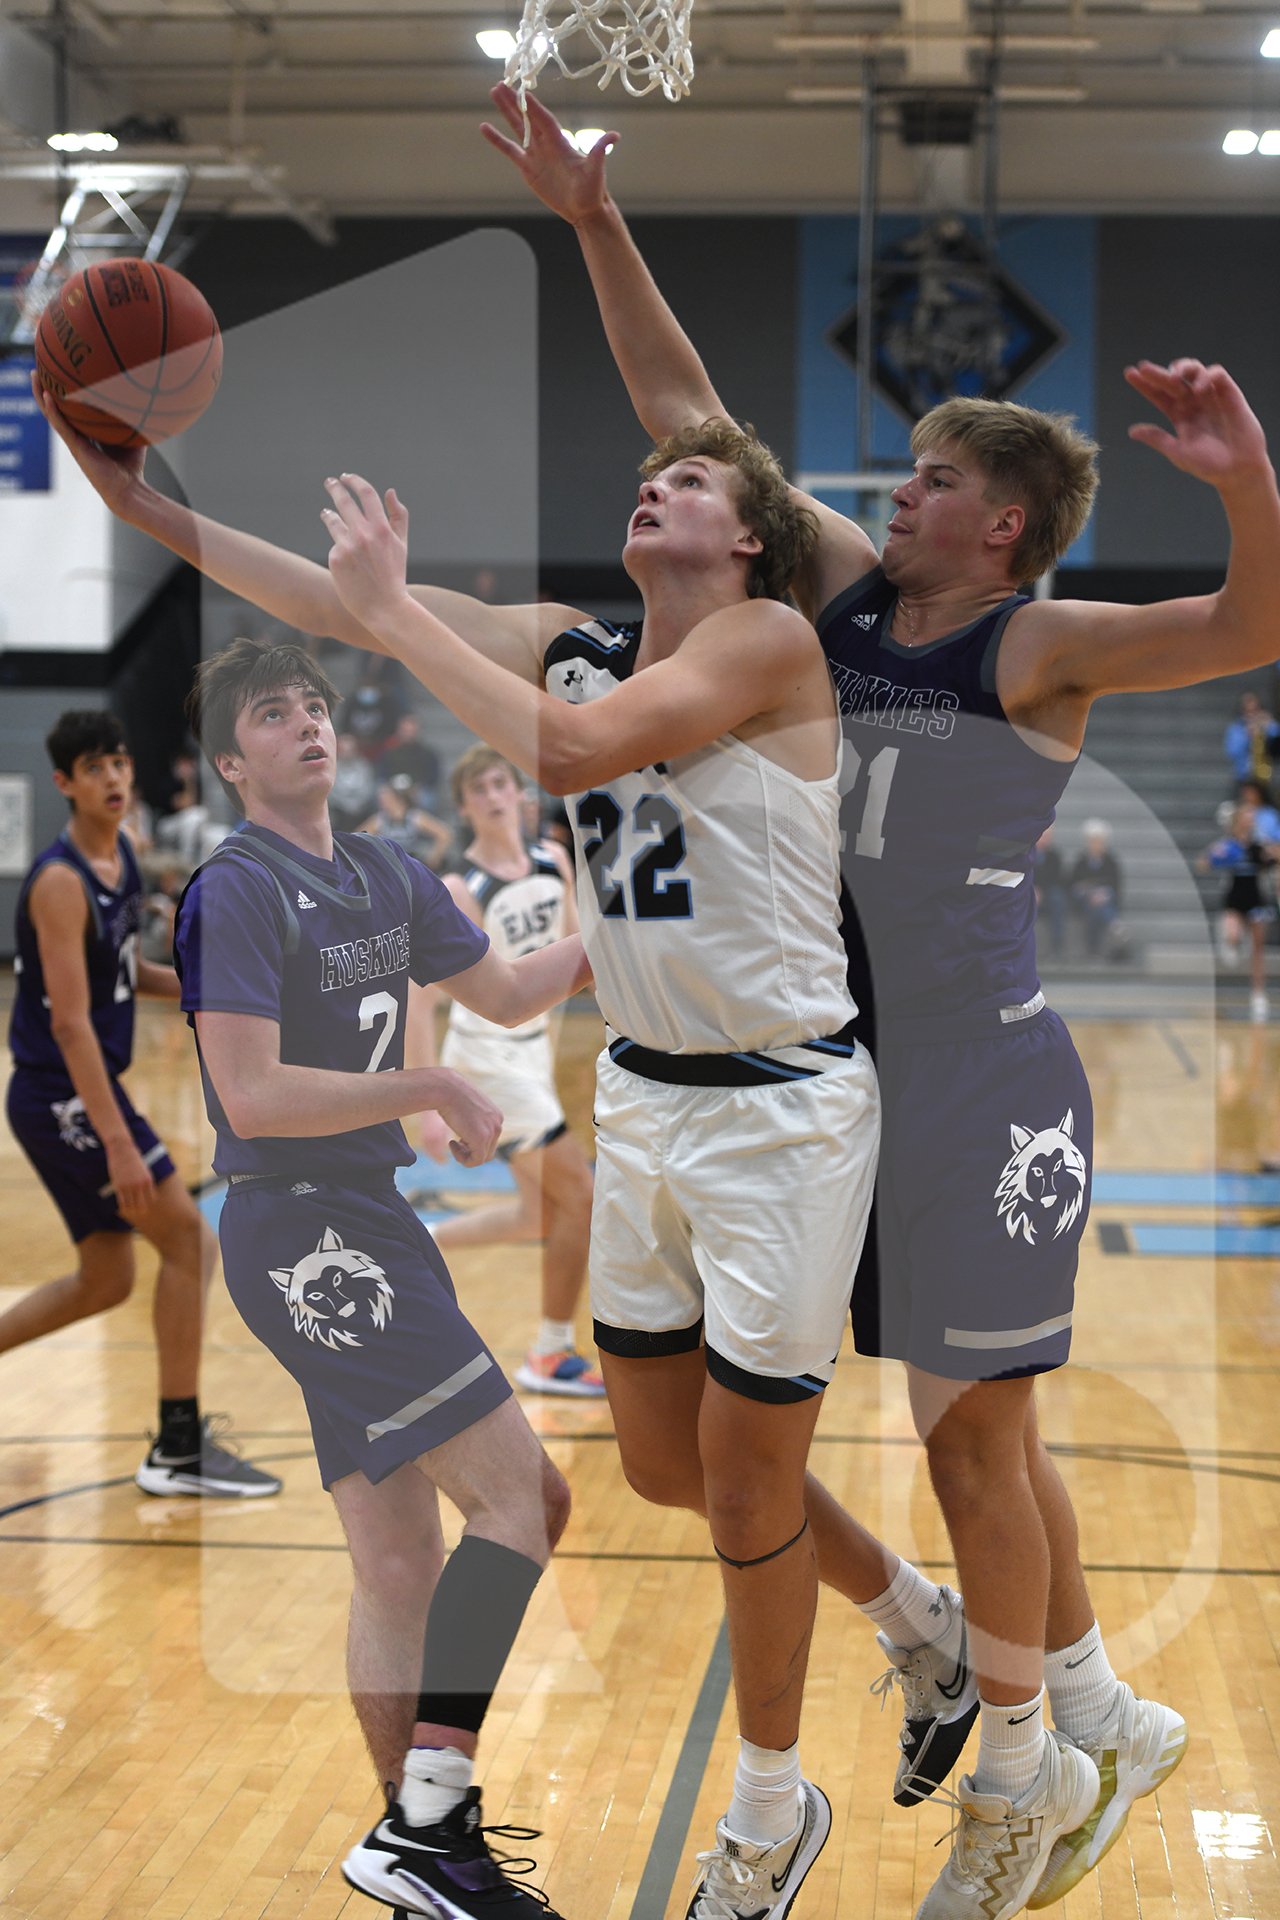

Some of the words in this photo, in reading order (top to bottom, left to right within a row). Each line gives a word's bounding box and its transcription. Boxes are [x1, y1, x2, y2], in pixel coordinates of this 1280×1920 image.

[575, 789, 694, 921] 22
[502, 898, 557, 944] EAST
[358, 990, 398, 1073] 2
